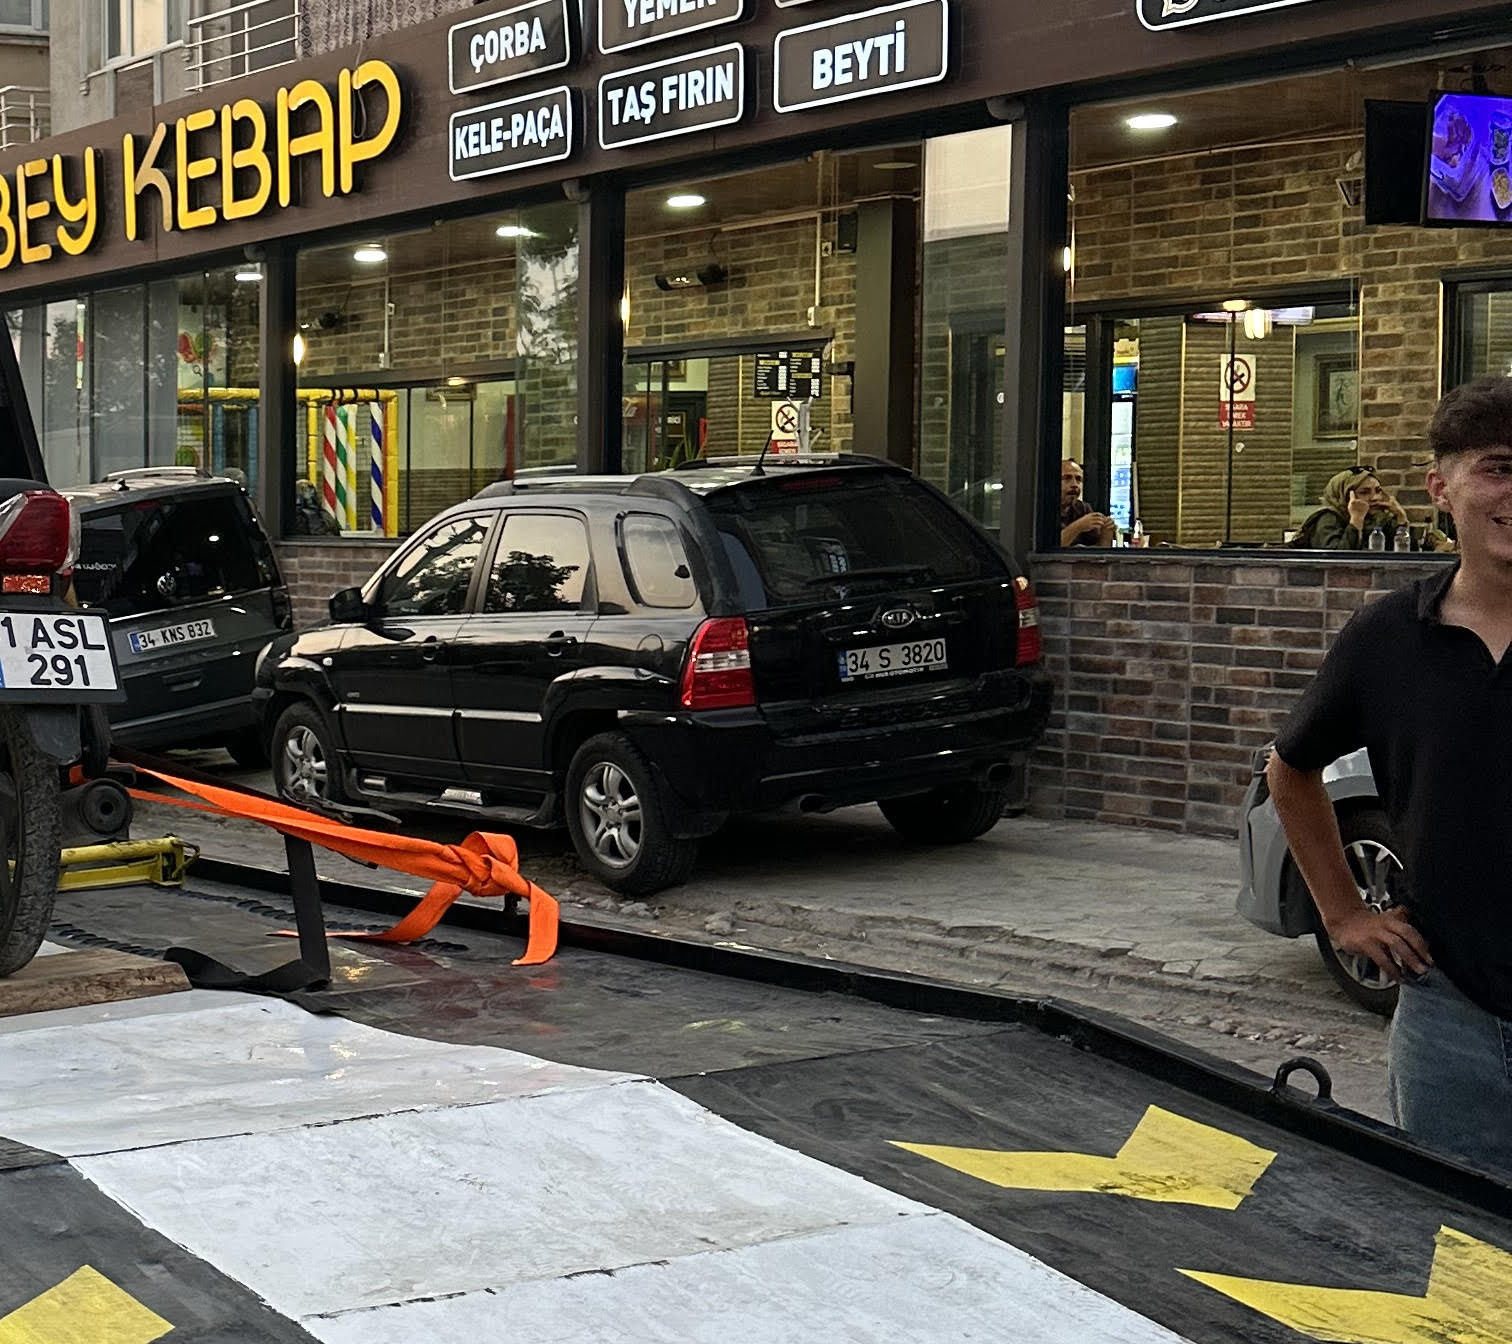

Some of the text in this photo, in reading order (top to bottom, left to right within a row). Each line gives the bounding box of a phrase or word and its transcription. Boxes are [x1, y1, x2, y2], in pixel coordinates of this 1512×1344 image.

[470, 17, 546, 73] ÇORBA
[812, 20, 906, 90] BEYTİ
[607, 62, 734, 125] TAŞ FIRIN
[123, 59, 402, 242] KEBAP
[455, 104, 564, 160] KELE-PAÇA
[31, 618, 105, 651] ASL
[139, 622, 211, 648] 34 KNS 832
[848, 651, 870, 672] 34
[879, 648, 890, 668] S
[902, 641, 944, 665] 3820
[28, 654, 90, 686] 291
